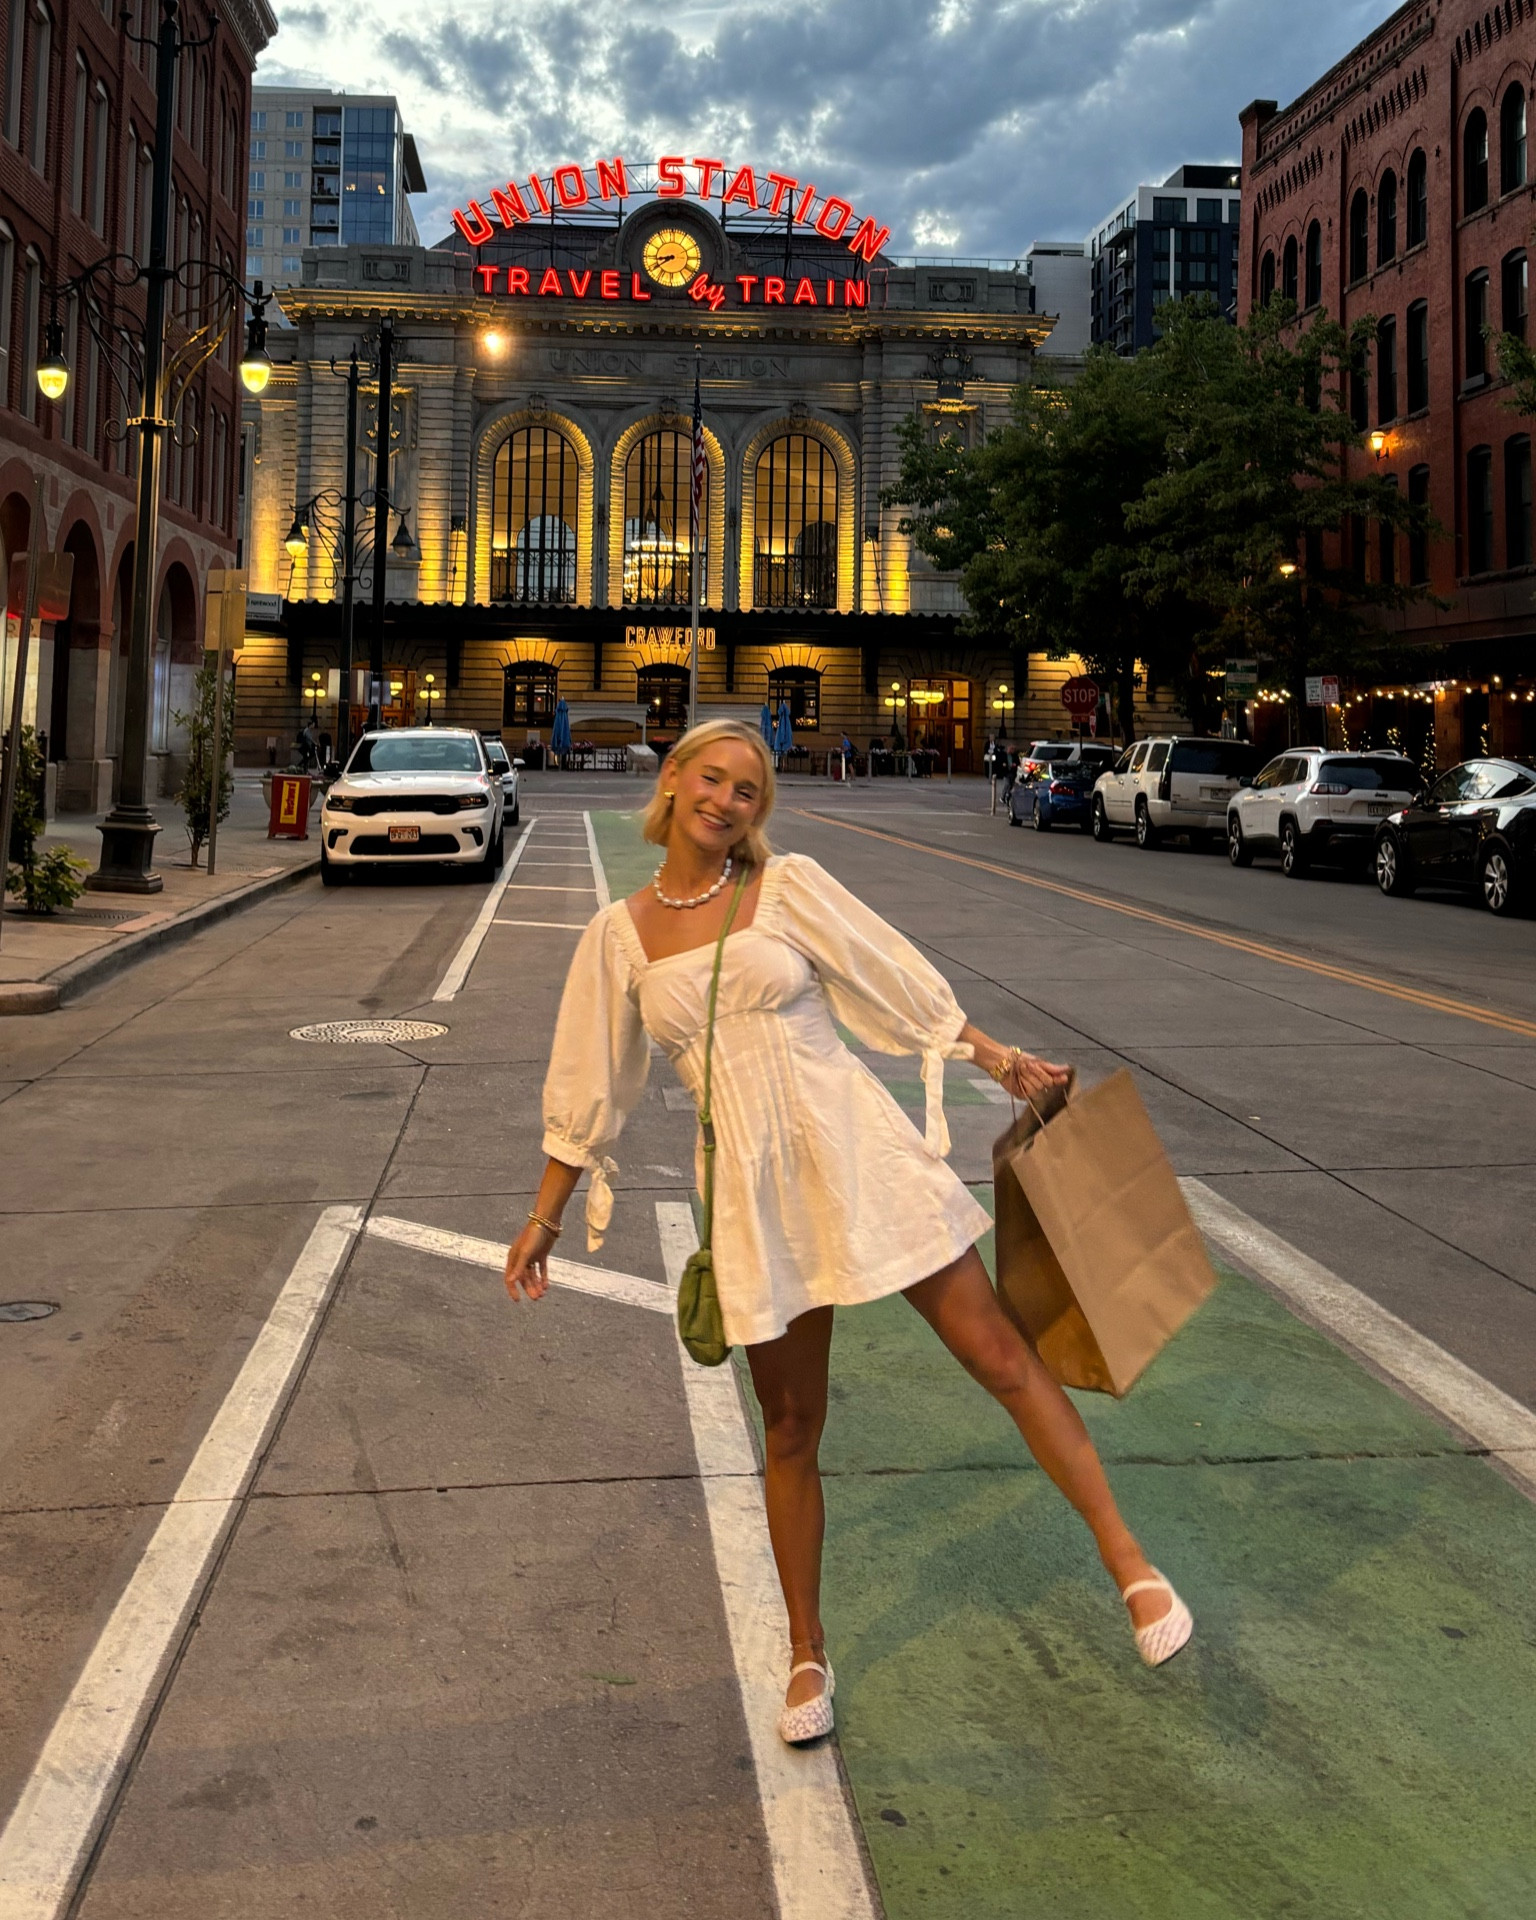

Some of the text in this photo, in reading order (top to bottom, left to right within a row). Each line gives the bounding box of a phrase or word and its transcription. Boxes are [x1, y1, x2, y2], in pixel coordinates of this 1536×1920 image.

[450, 156, 629, 247] UNION
[656, 155, 891, 264] STATION
[477, 265, 866, 312] TRAVEL by TRAIN
[548, 351, 790, 378] UNION STATION
[625, 626, 716, 650] CRAWFORD
[1064, 688, 1096, 703] STOP
